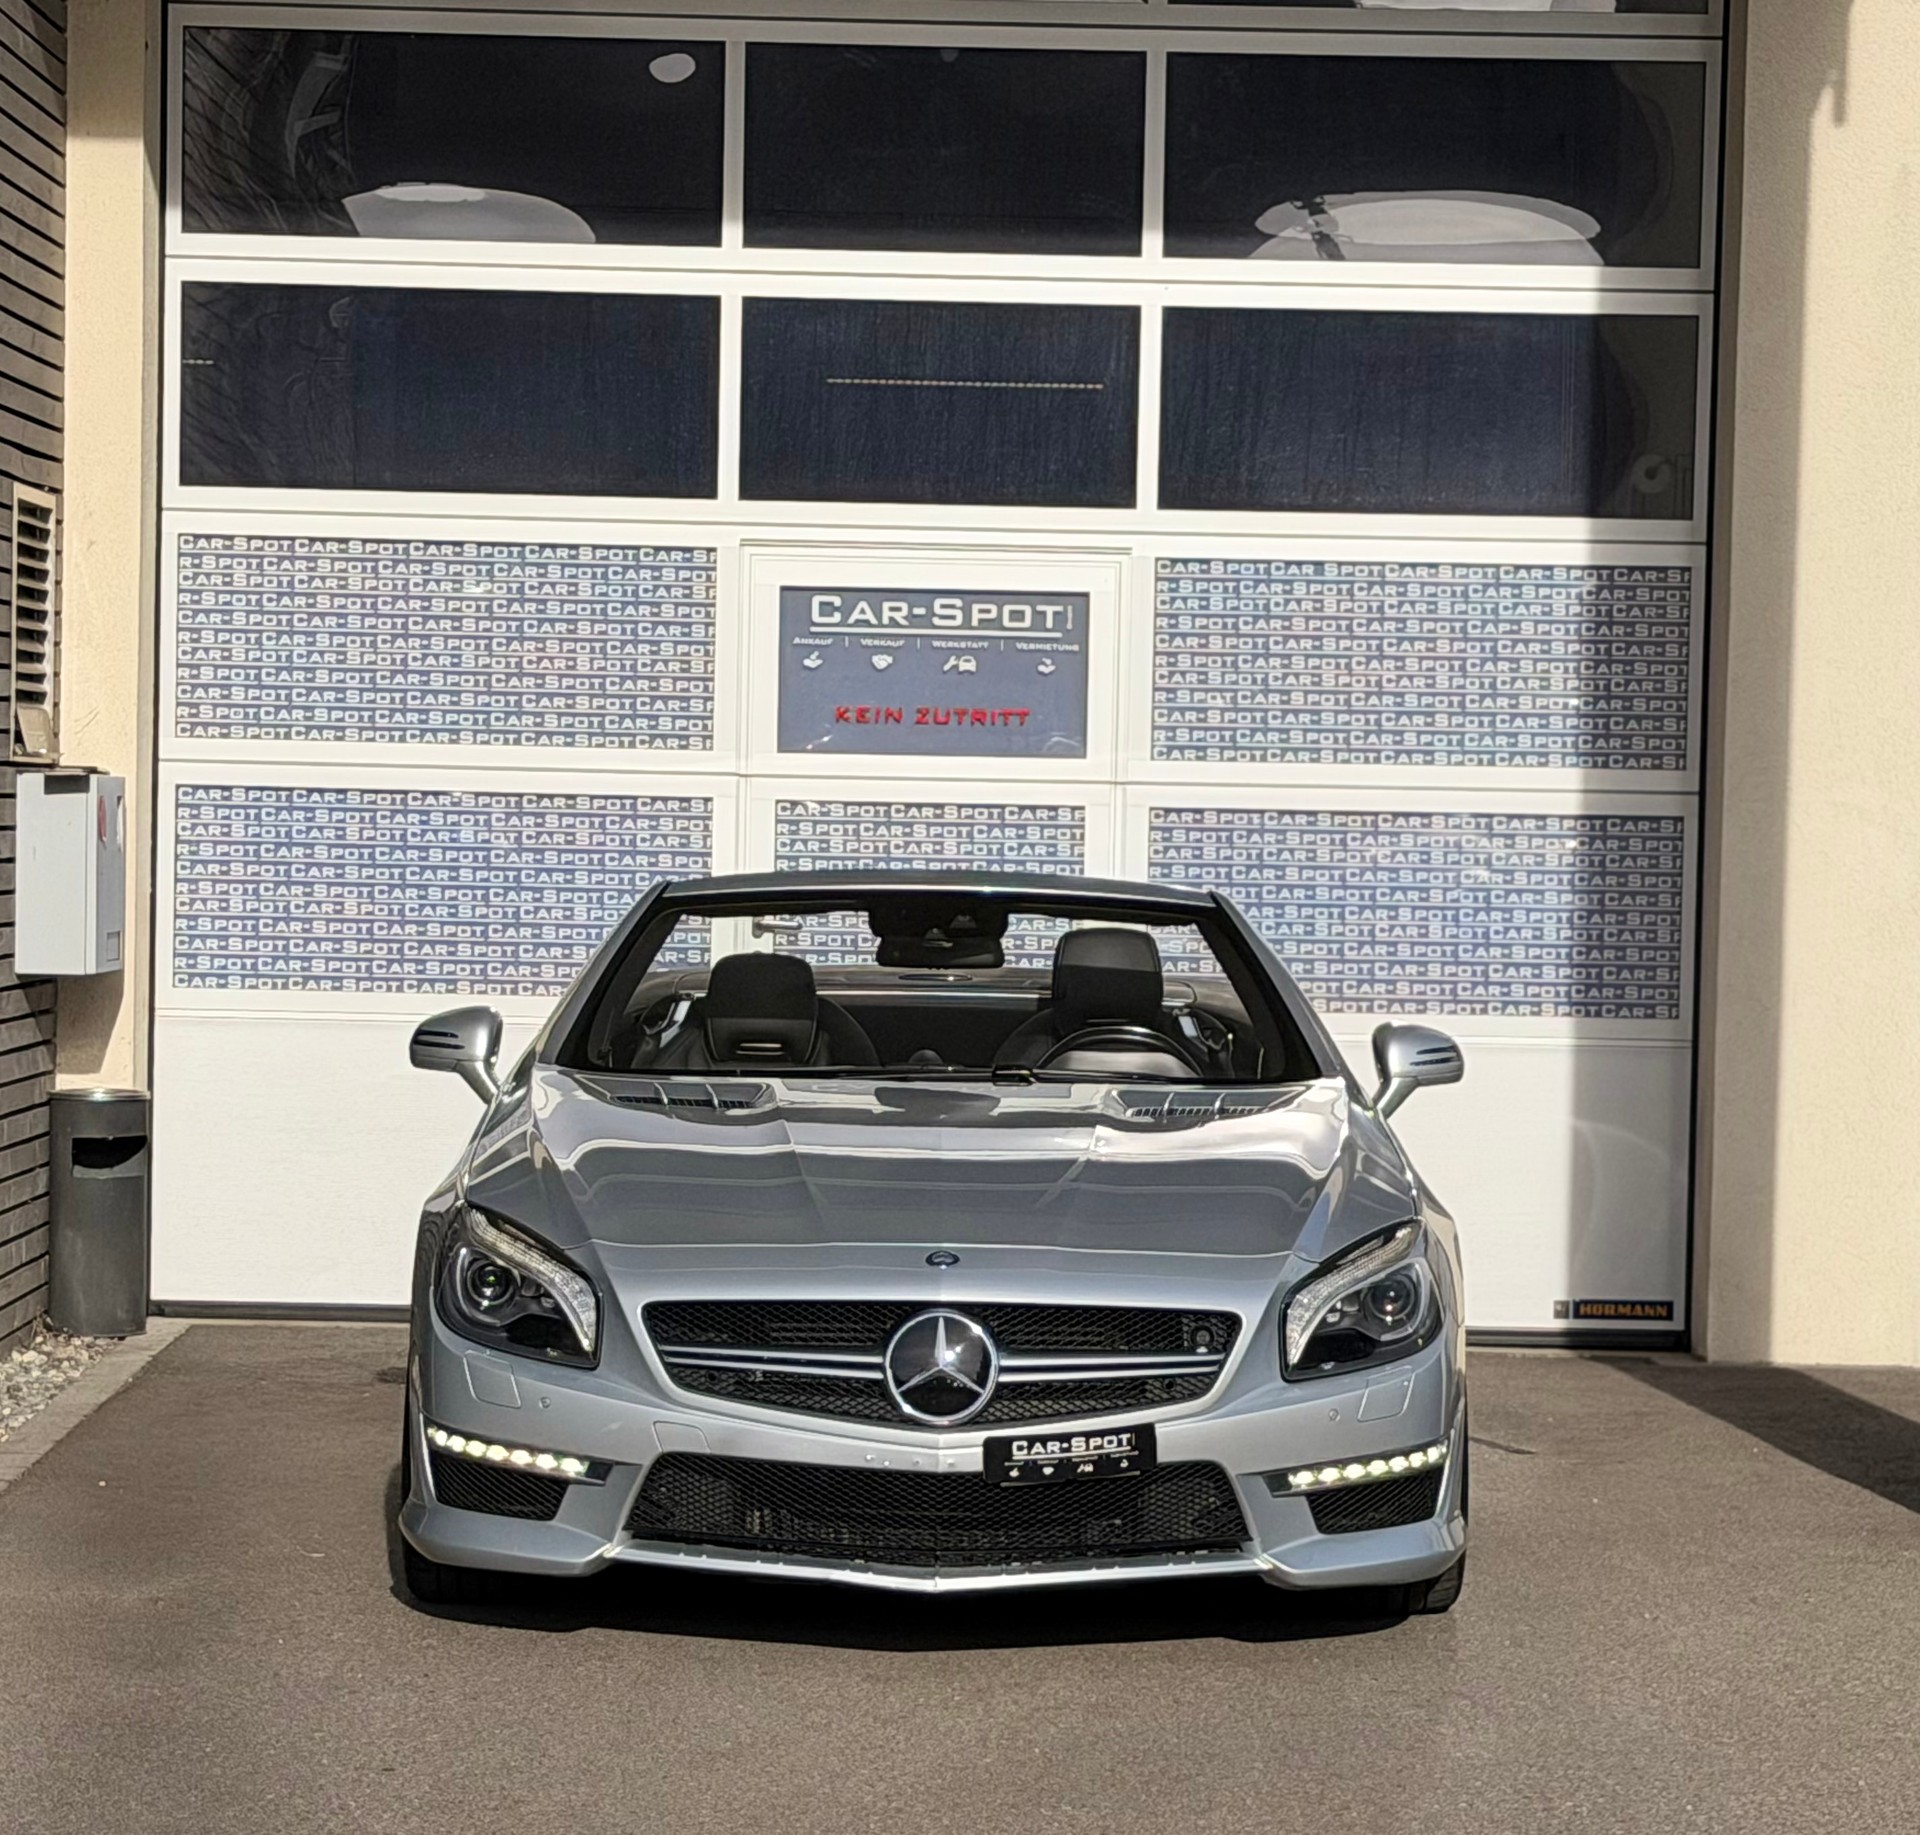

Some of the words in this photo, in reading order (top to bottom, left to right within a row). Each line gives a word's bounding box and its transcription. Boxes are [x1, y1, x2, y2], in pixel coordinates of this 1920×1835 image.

[811, 594, 1063, 629] CAR-SPOT
[834, 706, 903, 725] KEIN
[915, 707, 1030, 726] ZUTRITT
[1012, 1433, 1131, 1456] CAR-SPOT
